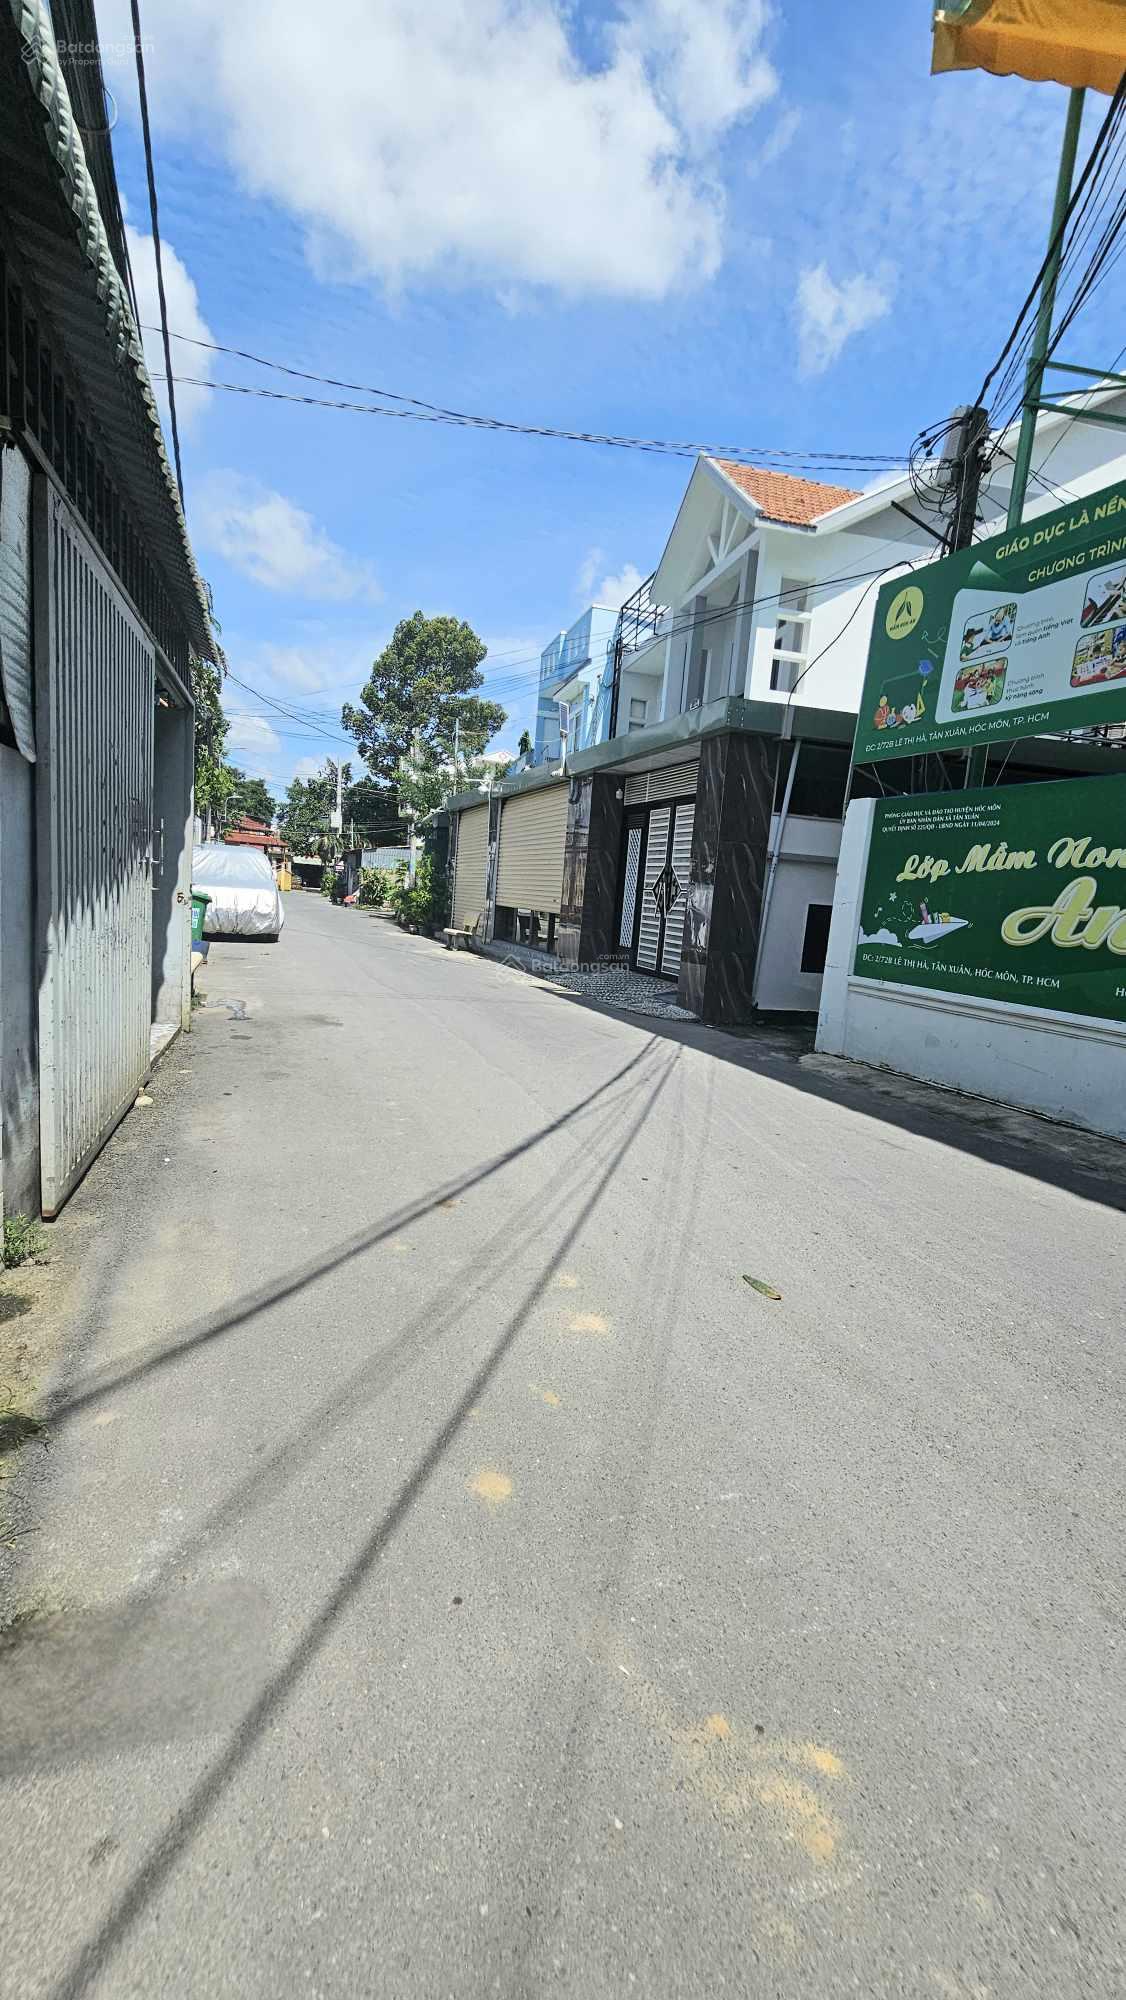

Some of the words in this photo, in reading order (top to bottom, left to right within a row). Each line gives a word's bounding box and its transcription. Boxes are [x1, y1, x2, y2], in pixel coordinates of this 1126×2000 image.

[995, 537, 1030, 560] GIÁO
[1033, 521, 1066, 544] DỤC
[1069, 509, 1090, 531] LÀ
[1028, 552, 1086, 582] CHƯƠNG
[928, 730, 943, 740] TÂN
[968, 723, 987, 735] HÓC
[1013, 716, 1025, 726] TP.
[1027, 711, 1050, 723] HCM
[896, 855, 951, 883] Lớp
[955, 842, 1038, 874] Mầm
[1047, 836, 1126, 869] Non
[894, 956, 902, 966] LÊ
[904, 958, 915, 969] THỊ
[931, 959, 947, 972] TÂN
[949, 964, 973, 977] XUÂN,
[974, 966, 994, 979] HÓC
[996, 970, 1019, 984] MÔN,
[1022, 975, 1034, 985] TP.
[1036, 976, 1060, 989] HCM
